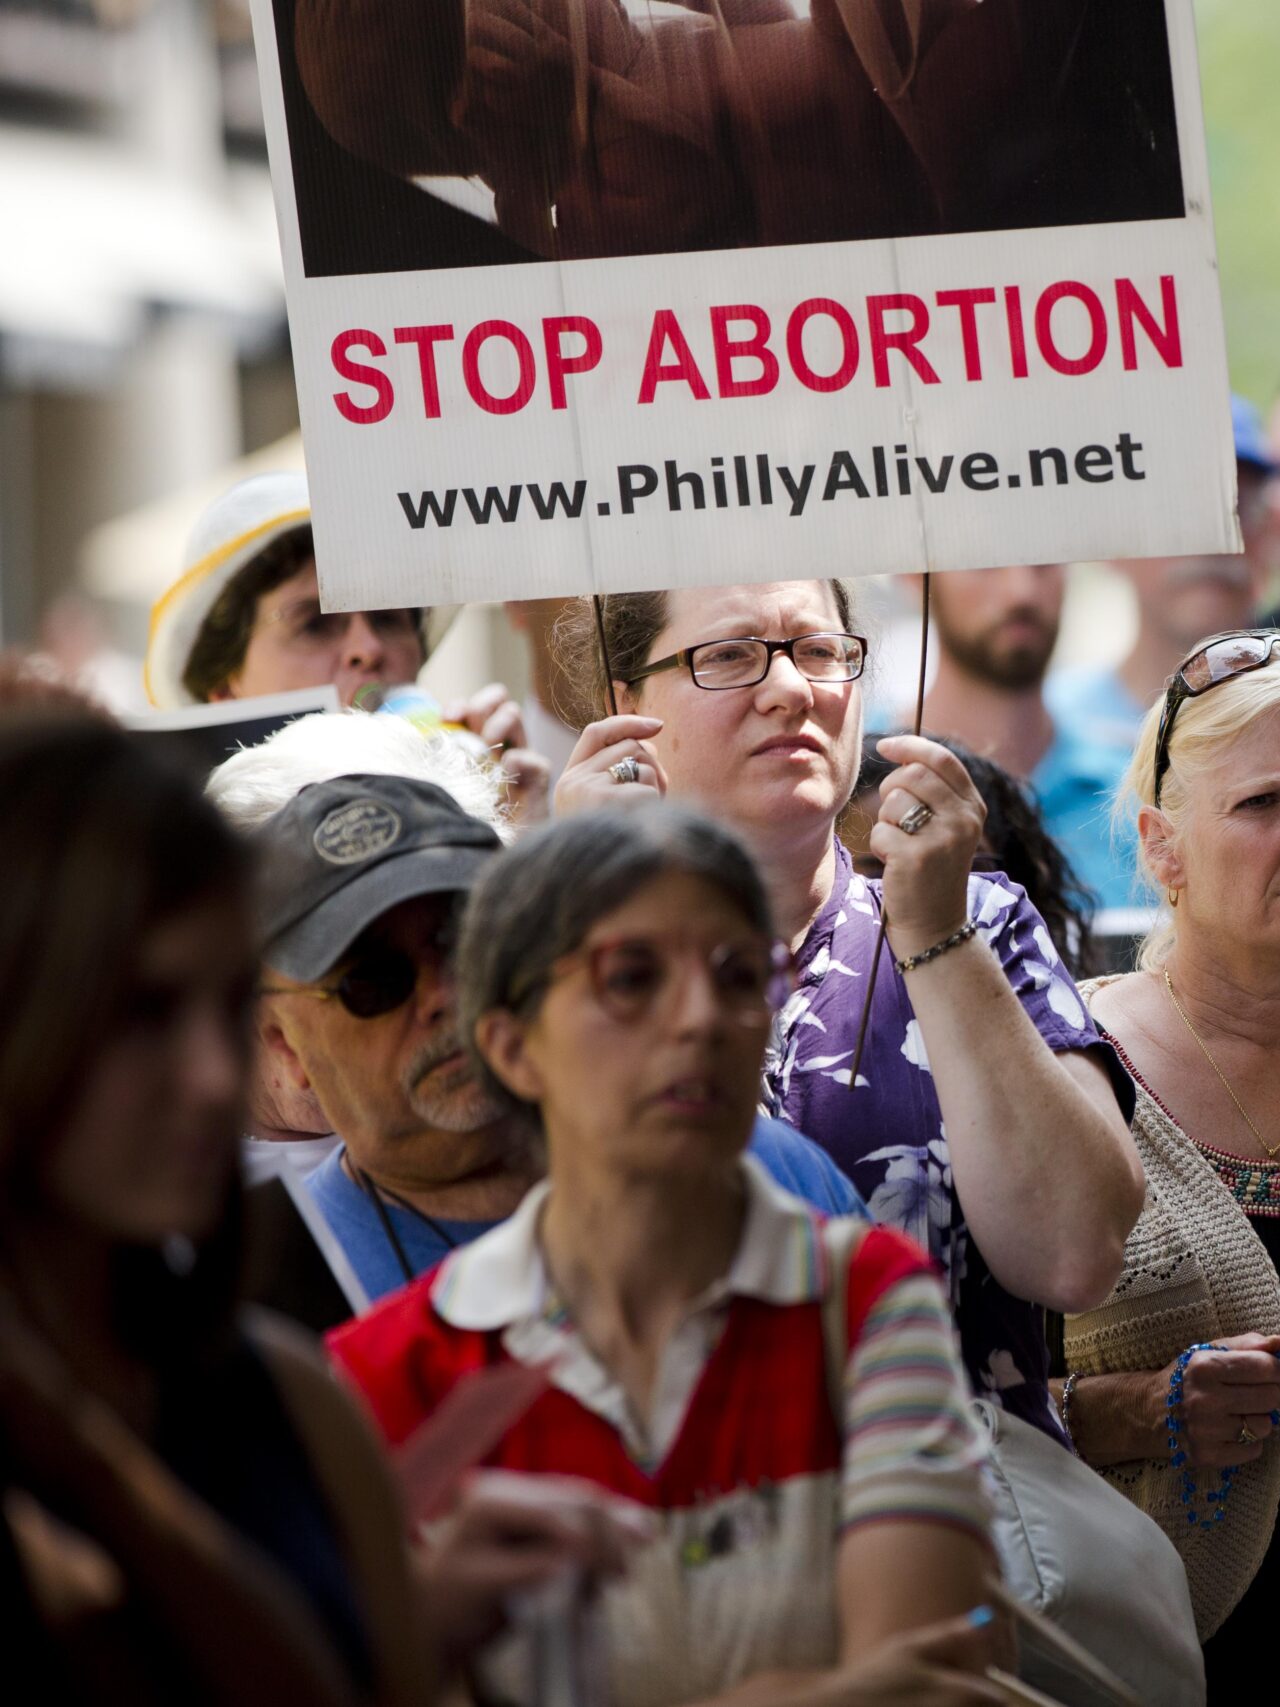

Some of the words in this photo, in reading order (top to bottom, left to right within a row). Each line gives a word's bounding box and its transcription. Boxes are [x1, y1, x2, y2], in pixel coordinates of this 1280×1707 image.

[330, 316, 603, 424] STOP
[638, 275, 1184, 404] ABORTION
[398, 432, 1146, 530] www.PhillyAlive.net
